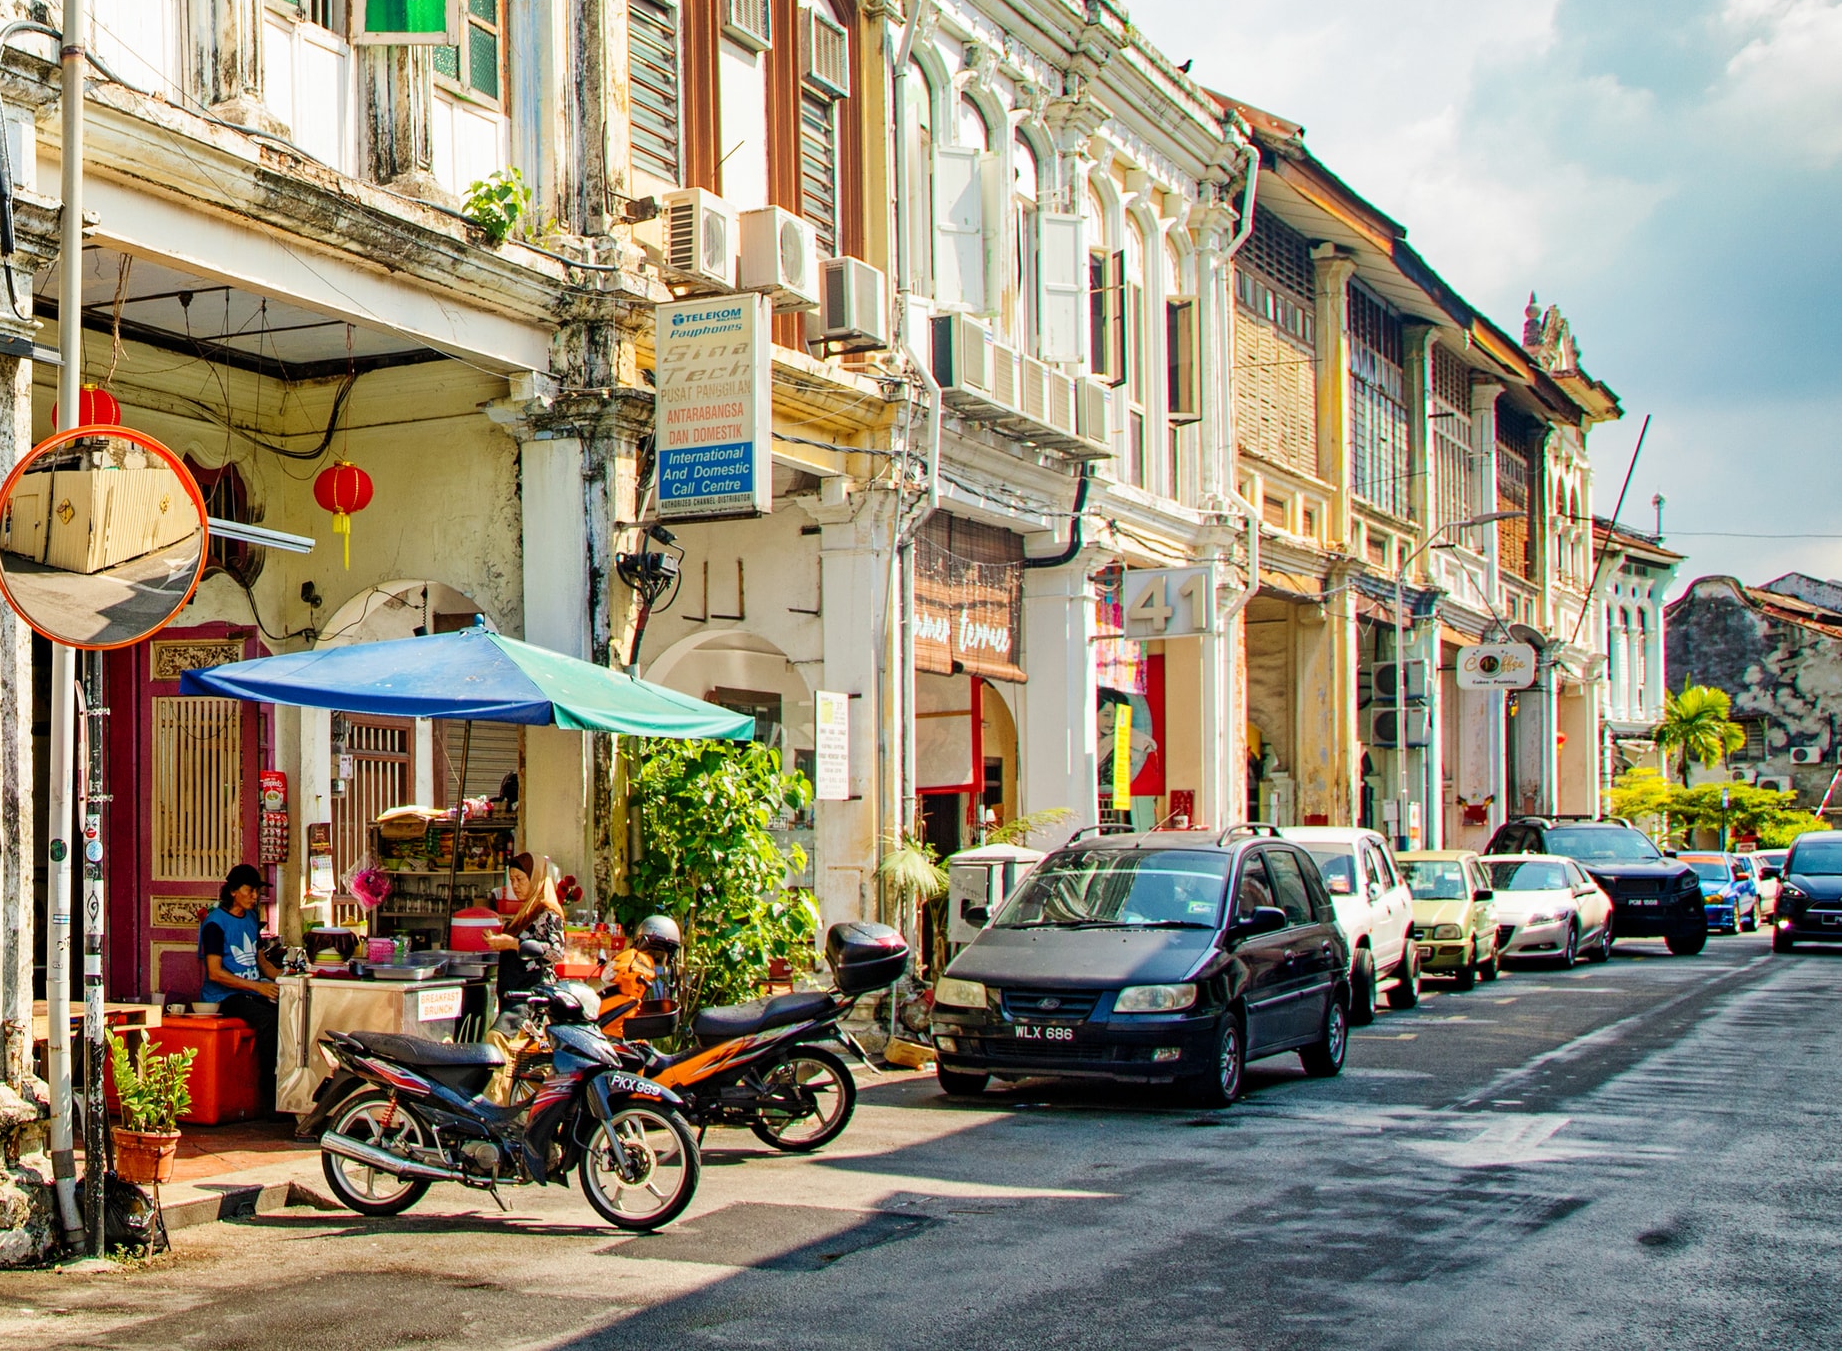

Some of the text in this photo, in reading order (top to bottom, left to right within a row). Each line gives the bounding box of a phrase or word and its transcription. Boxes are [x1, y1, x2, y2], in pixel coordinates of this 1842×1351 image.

[685, 308, 742, 322] TELEKOM
[670, 323, 742, 338] Payphones
[663, 342, 749, 364] Sina
[662, 360, 750, 385] Tech
[661, 379, 751, 403] PUSAT PANGGILAN
[667, 402, 744, 424] ANTARABANGSA
[669, 424, 743, 445] DAN DOMESTIK
[669, 446, 745, 465] International
[662, 461, 750, 481] And Domestic
[672, 480, 741, 496] Call Centre
[661, 493, 751, 509] AUTHORIZED CHANNEL DISTRIBUTOR
[1128, 574, 1206, 631] 41
[421, 991, 459, 1004] BREAKFAST
[424, 1004, 454, 1016] BRUNCH
[1014, 1025, 1073, 1040] WLX 686
[611, 1074, 662, 1096] PKX 989
